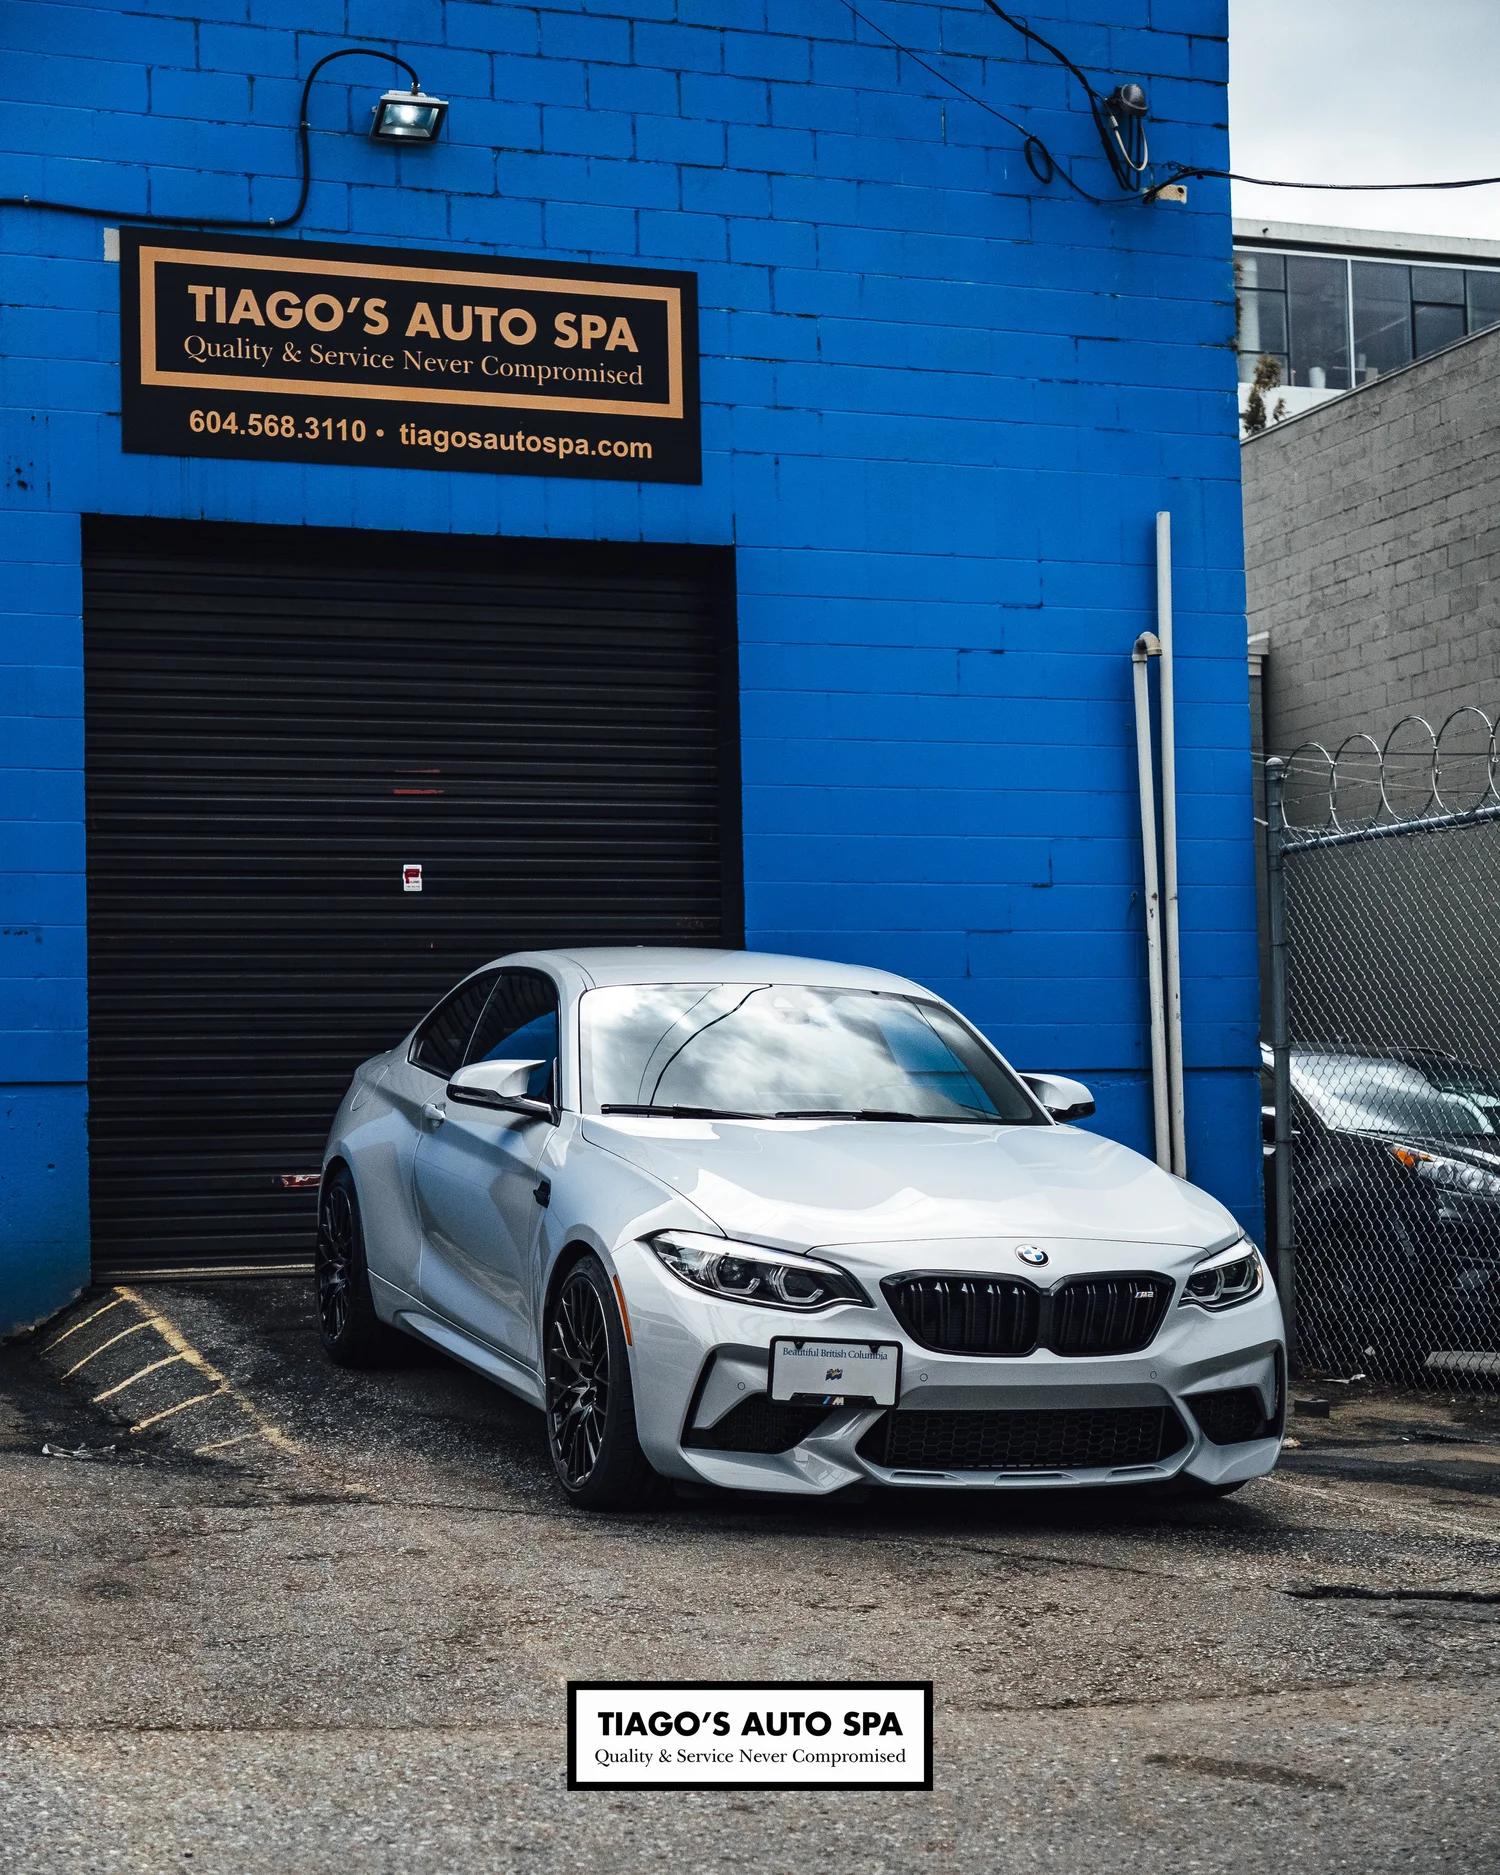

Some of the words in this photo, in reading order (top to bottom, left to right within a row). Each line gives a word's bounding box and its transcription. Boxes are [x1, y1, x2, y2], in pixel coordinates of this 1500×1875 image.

[188, 285, 389, 336] TIAGO’S
[405, 302, 537, 346] AUTO
[554, 311, 639, 353] SPA
[184, 335, 273, 368] Quality
[282, 341, 302, 363] &
[310, 344, 395, 369] Service
[403, 350, 474, 374] Never
[481, 355, 644, 386] Compromised
[189, 409, 367, 443] 604.568.3110
[399, 422, 653, 460] tiagosautospa.com
[782, 1347, 819, 1357] Beautiful
[821, 1348, 847, 1358] British
[847, 1350, 888, 1360] Columbia
